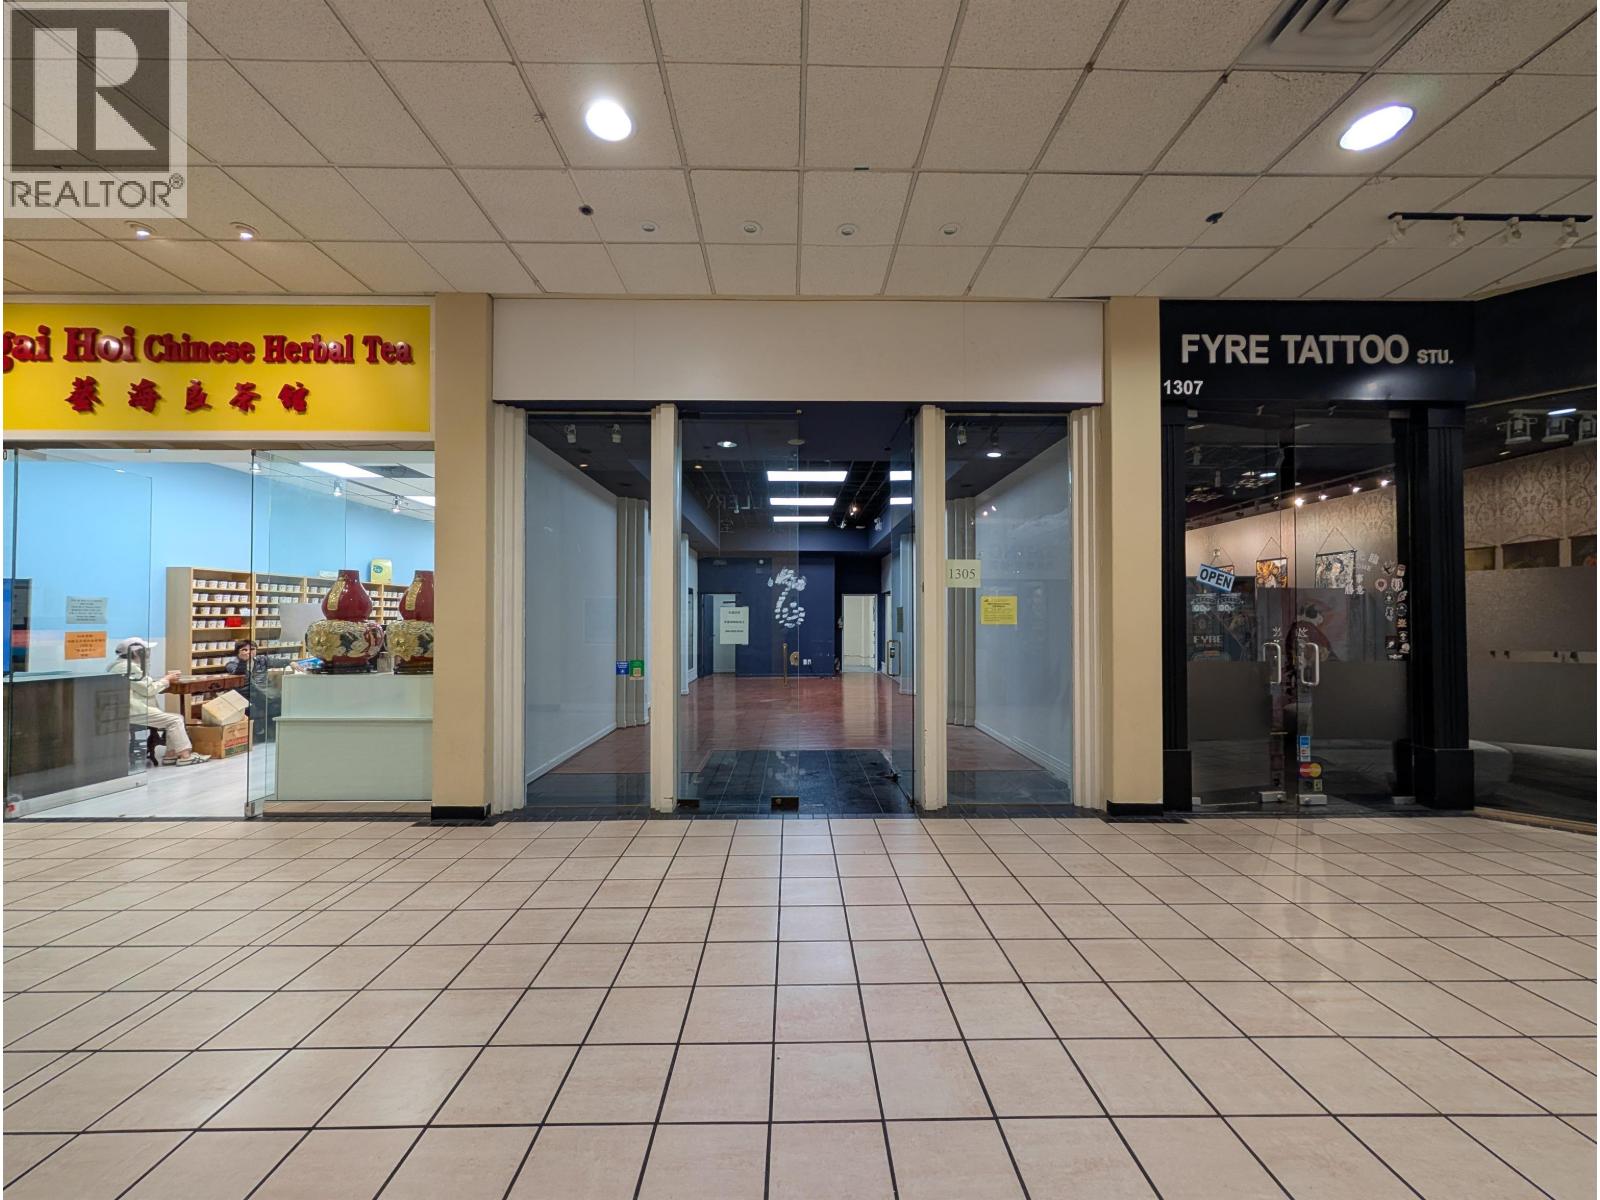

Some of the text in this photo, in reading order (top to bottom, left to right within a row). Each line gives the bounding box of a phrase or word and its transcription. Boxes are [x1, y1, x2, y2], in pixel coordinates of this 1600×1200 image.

[63, 325, 138, 362] Hoi
[144, 333, 255, 363] Chinese
[263, 334, 355, 364] Herbal
[362, 335, 414, 364] Tea
[1181, 334, 1454, 365] FYRE TATTOO STU.
[1163, 379, 1204, 396] 1307
[949, 568, 976, 580] 1305
[1199, 568, 1233, 590] OPEN
